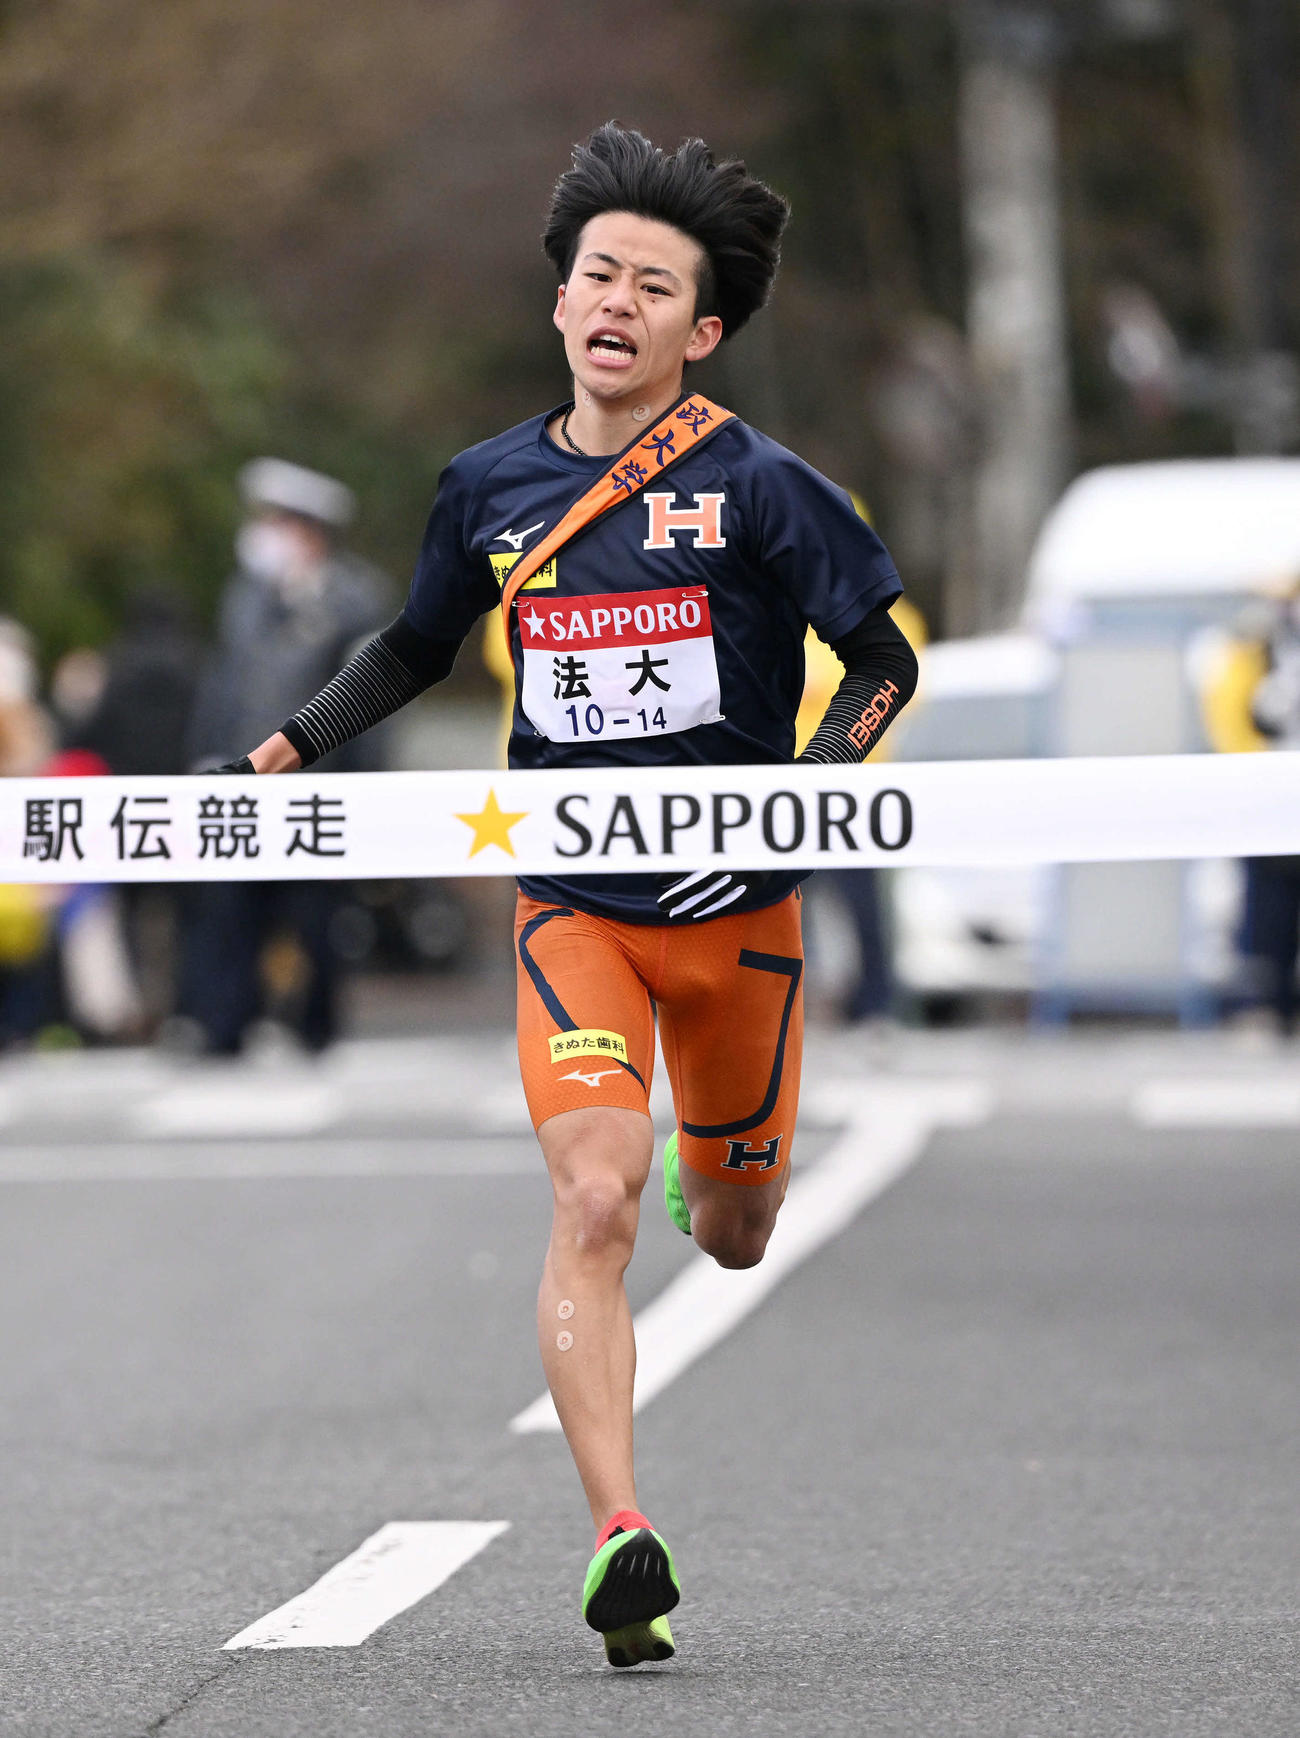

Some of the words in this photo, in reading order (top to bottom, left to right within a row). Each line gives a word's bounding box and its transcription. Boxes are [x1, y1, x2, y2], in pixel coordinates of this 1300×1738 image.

[643, 492, 727, 550] H
[549, 600, 701, 641] SAPPORO
[565, 703, 667, 736] 10-14
[847, 679, 899, 750] HOSEI
[22, 794, 346, 861] 駅伝競走
[554, 788, 914, 858] SAPPORO
[552, 1036, 625, 1055] きぬた歯科
[721, 1134, 783, 1171] H
